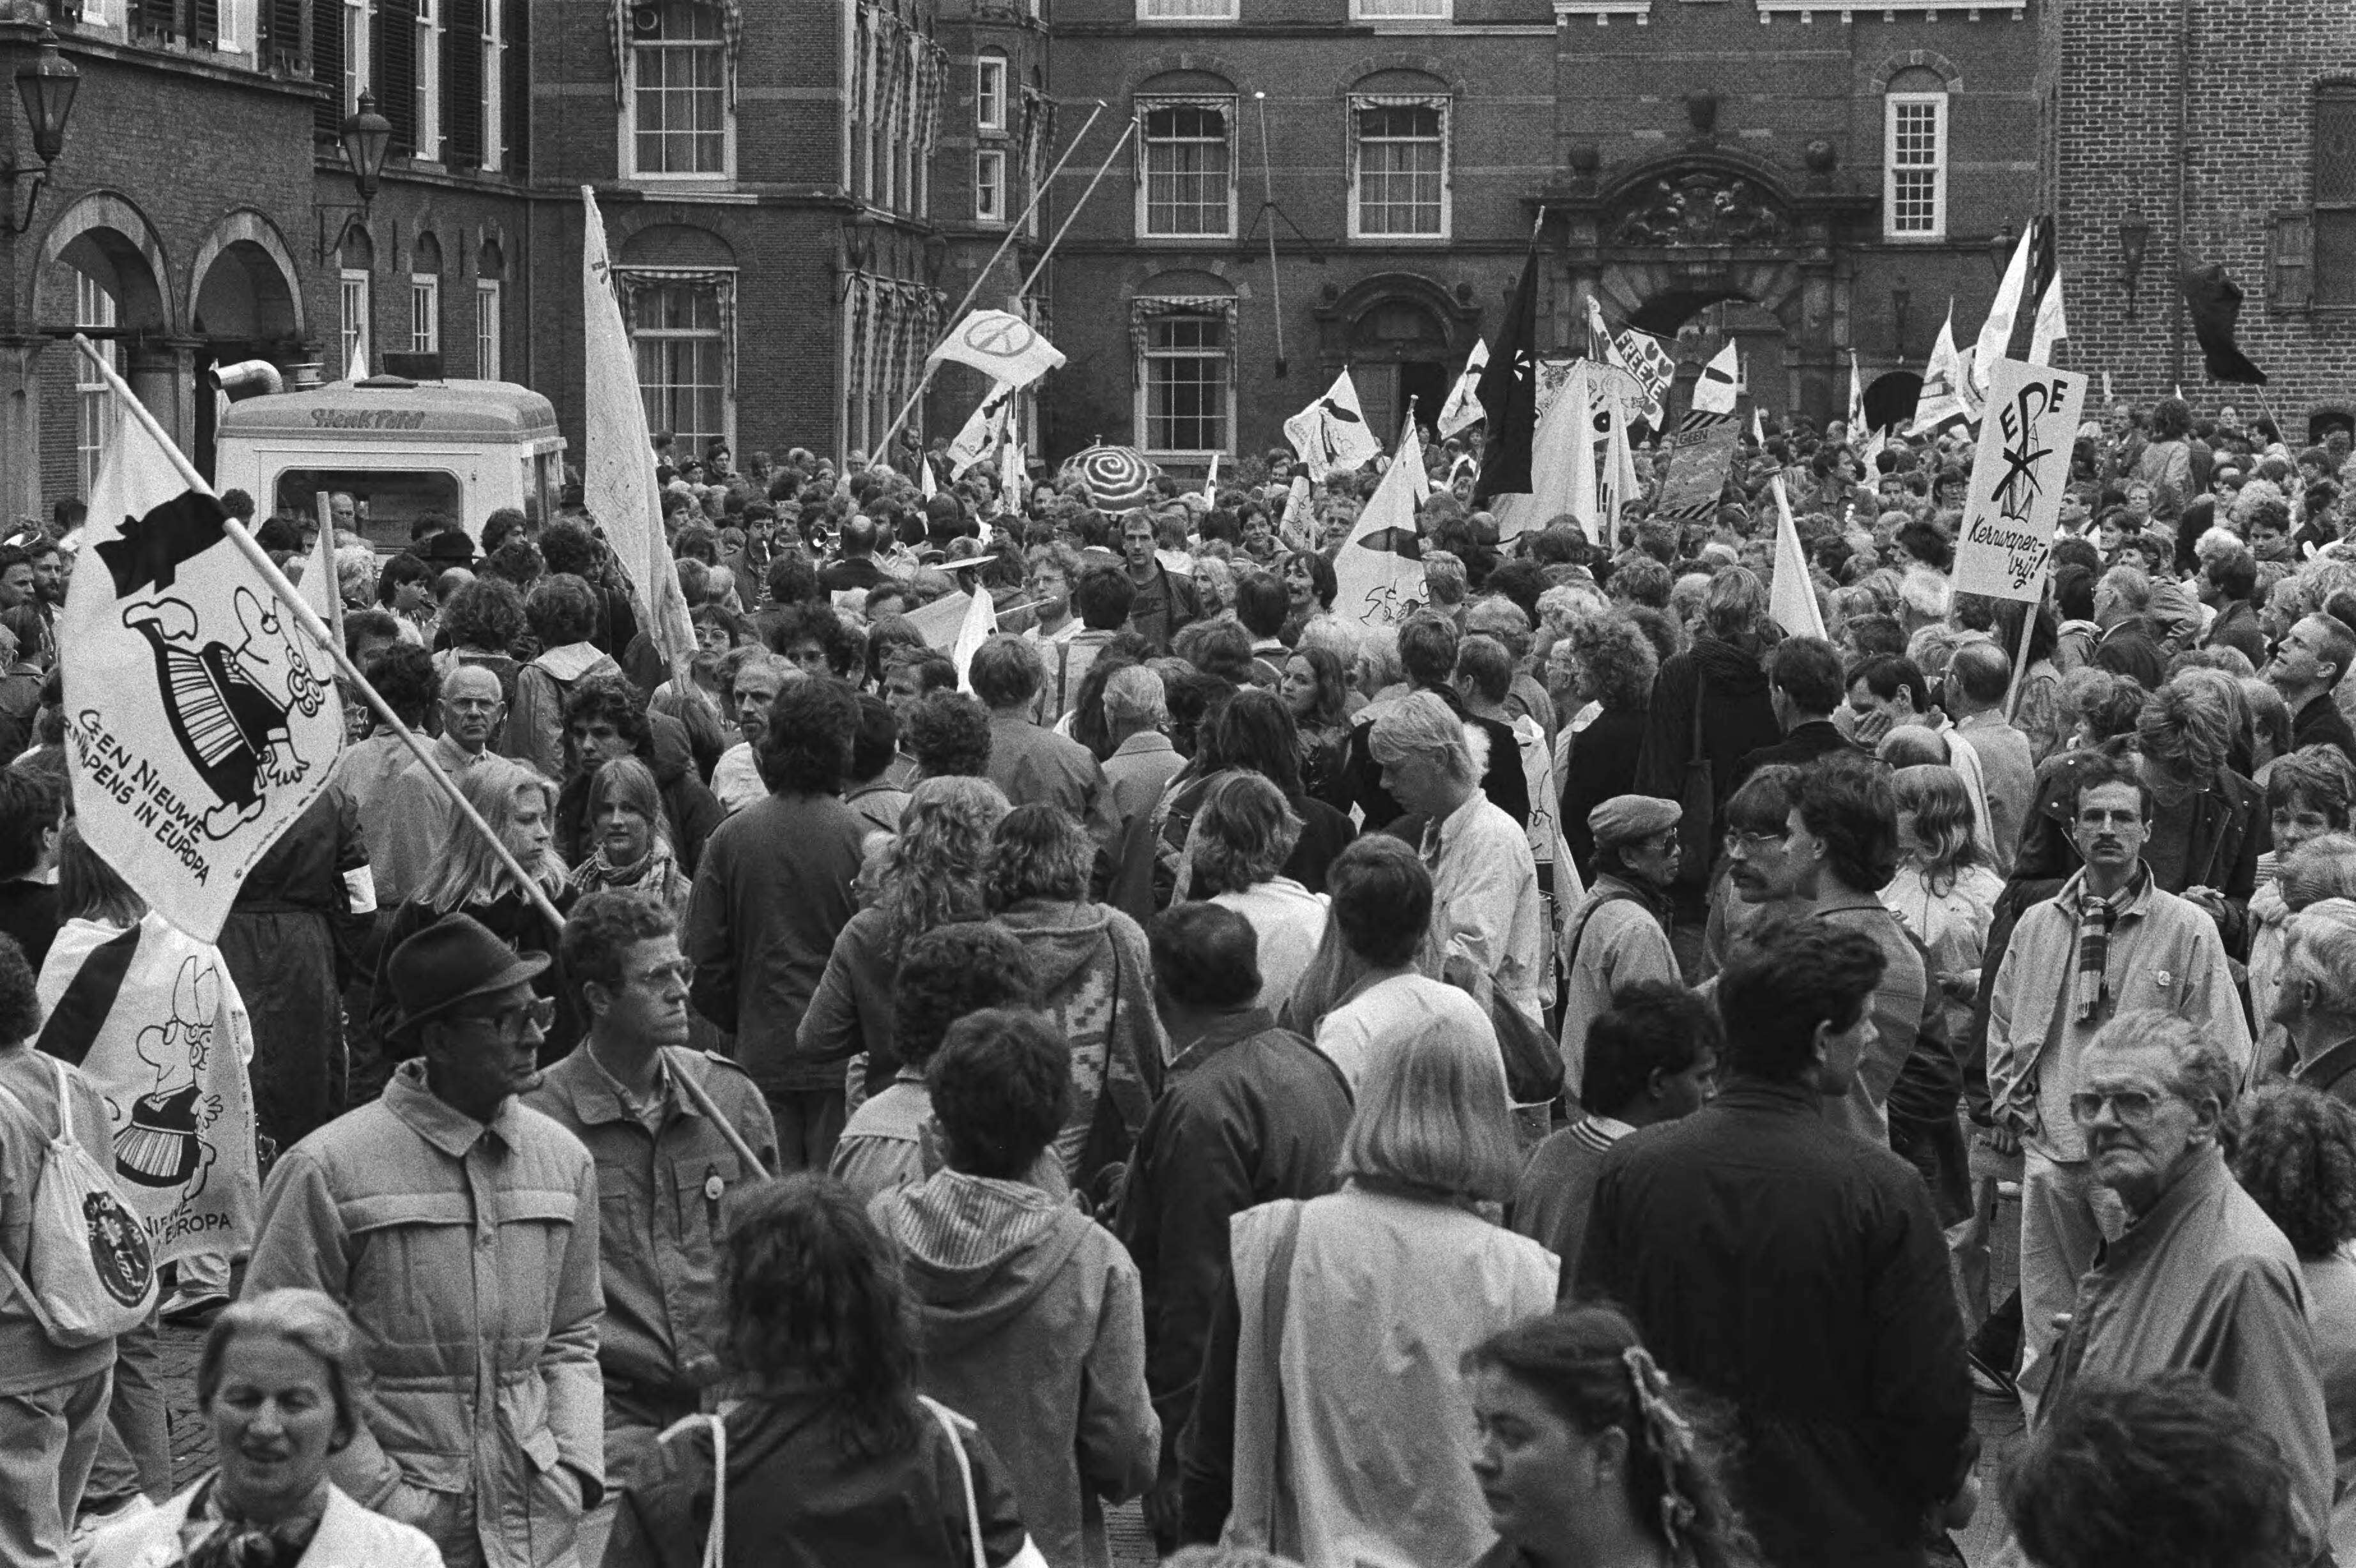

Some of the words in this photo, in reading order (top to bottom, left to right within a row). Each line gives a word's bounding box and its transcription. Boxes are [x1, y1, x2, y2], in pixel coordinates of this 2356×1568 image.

[1615, 331, 1667, 400] FREEZE
[1679, 430, 1709, 445] GEEN
[79, 709, 132, 769] GEEN
[130, 759, 202, 844] NIEUWE
[134, 801, 160, 828] IN
[155, 819, 210, 887] EUROPA
